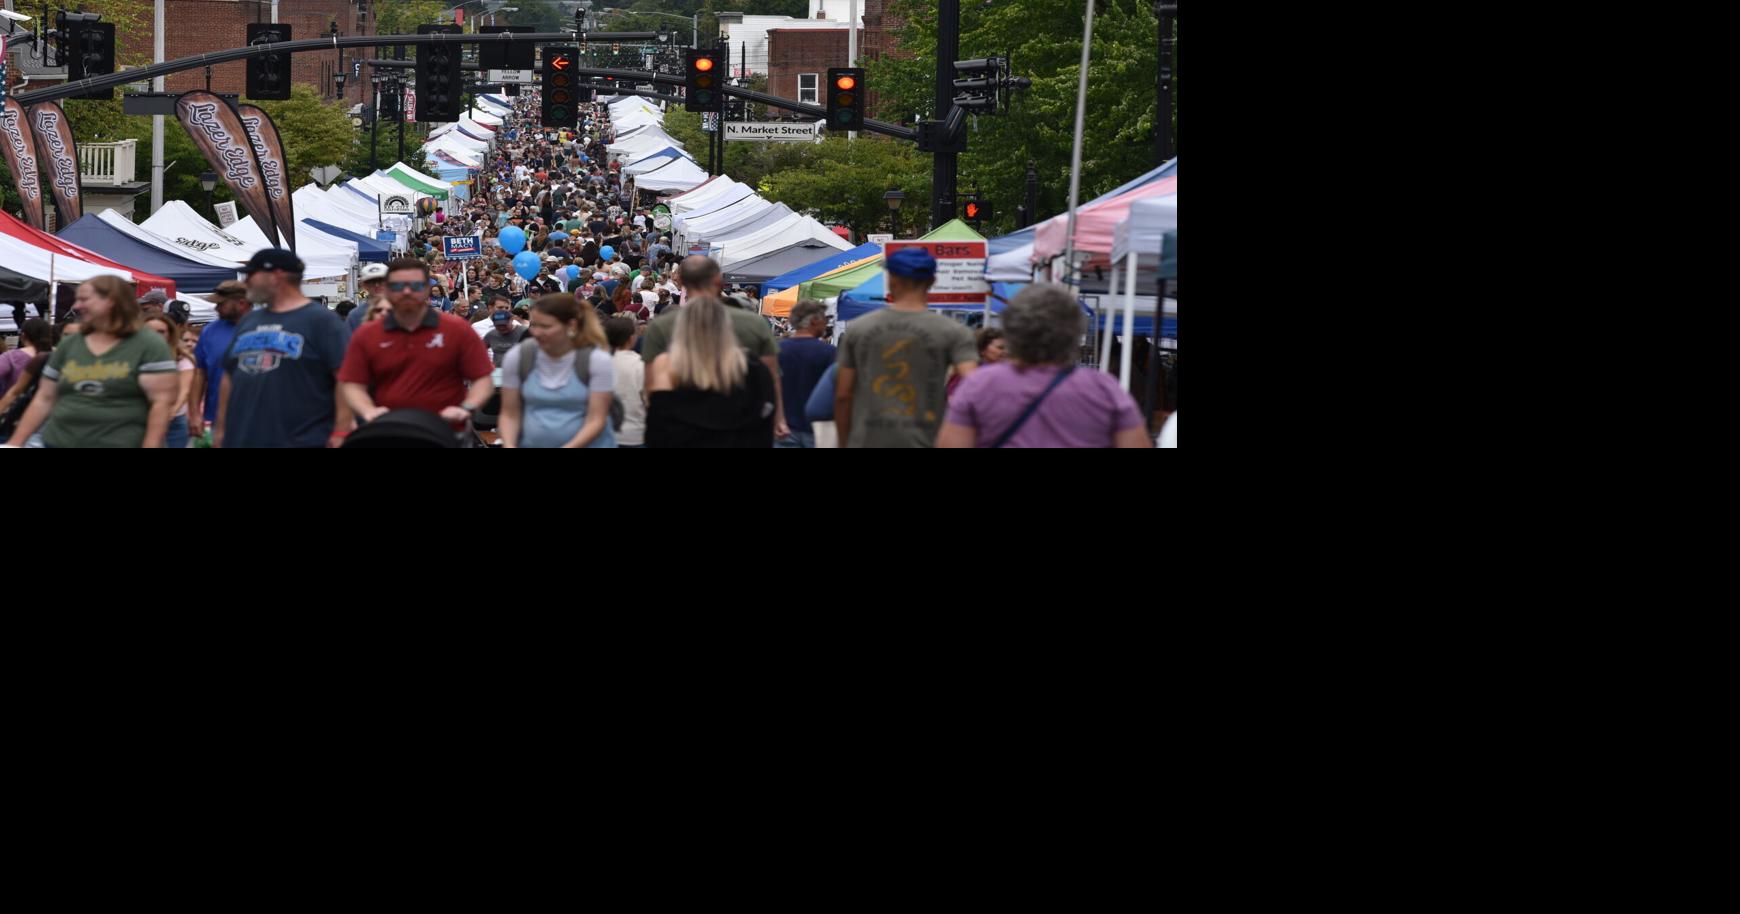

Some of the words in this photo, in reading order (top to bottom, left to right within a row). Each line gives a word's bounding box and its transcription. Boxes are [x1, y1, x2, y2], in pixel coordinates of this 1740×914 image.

[727, 125, 739, 134] N.
[741, 125, 778, 134] Market
[781, 126, 813, 135] Street
[222, 147, 255, 189] Edge
[450, 237, 473, 245] BETH
[936, 244, 971, 256] Bars
